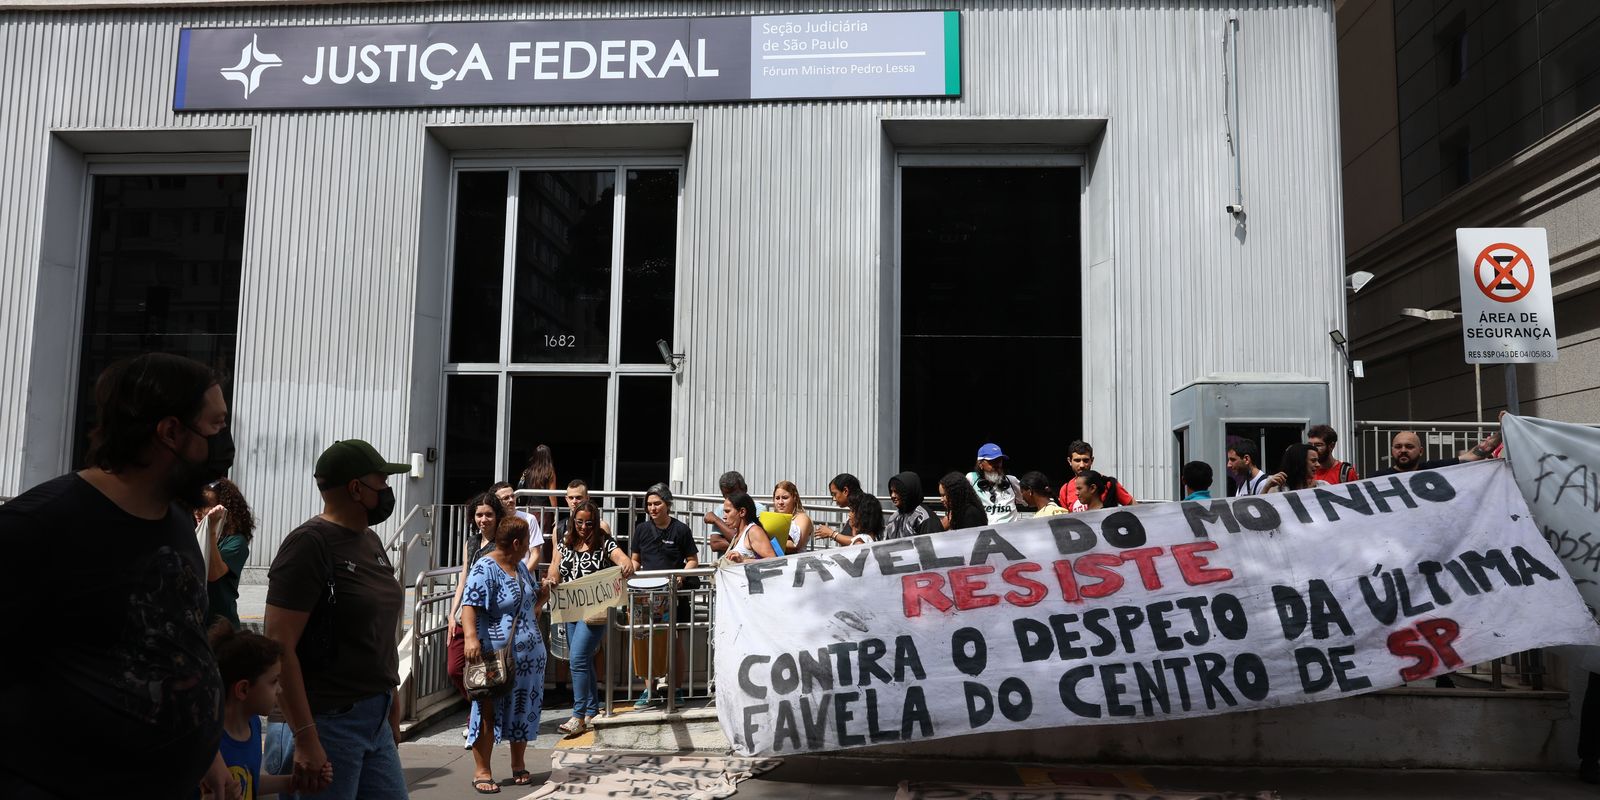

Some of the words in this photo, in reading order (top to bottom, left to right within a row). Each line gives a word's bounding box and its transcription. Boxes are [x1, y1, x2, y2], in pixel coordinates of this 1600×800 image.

[762, 22, 802, 36] Seção
[805, 20, 868, 34] Judiciária
[762, 39, 779, 51] de
[783, 39, 807, 51] São
[812, 38, 848, 50] Paulo
[302, 42, 493, 90] JUSTIÇA
[507, 39, 719, 81] FEDERAL
[763, 65, 798, 77] Fórum
[802, 64, 848, 76] Ministro
[850, 63, 883, 75] Pedro
[886, 63, 915, 74] Lessa
[1479, 310, 1516, 324] ÁREA
[1520, 312, 1538, 323] DE
[544, 334, 576, 347] 1682
[1467, 327, 1551, 341] SEGURANÇA
[1510, 350, 1519, 358] DE
[984, 503, 1012, 515] efisa
[744, 530, 1026, 595] FAVELA
[1048, 511, 1147, 555] DO
[1182, 472, 1456, 538] MOINHO
[902, 540, 1234, 618] RESISTE
[738, 635, 927, 700] CONTRA
[952, 627, 987, 676] O
[1013, 593, 1248, 662] DESPEJO
[1272, 578, 1355, 641] DA
[1359, 545, 1560, 626] ÚLTIMA
[743, 686, 934, 753] FAVELA
[964, 677, 1033, 729] DO
[1058, 652, 1270, 719] CENTRO
[1294, 645, 1372, 694] DE
[1386, 617, 1465, 682] SP
